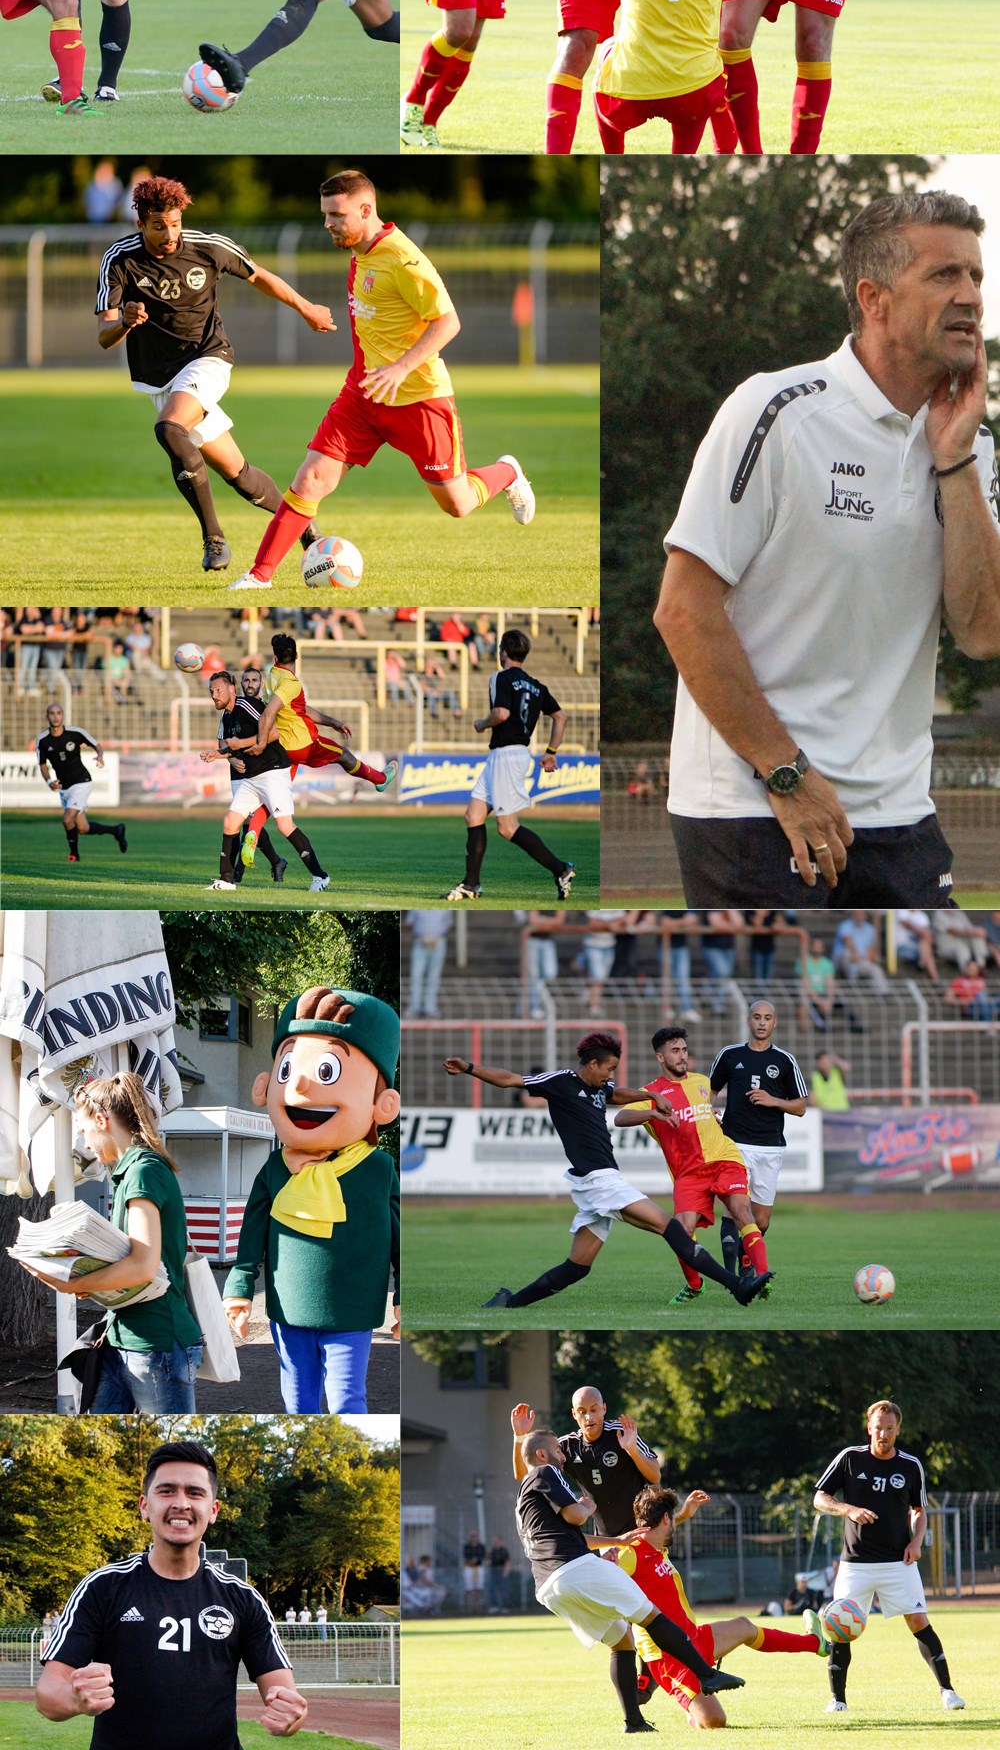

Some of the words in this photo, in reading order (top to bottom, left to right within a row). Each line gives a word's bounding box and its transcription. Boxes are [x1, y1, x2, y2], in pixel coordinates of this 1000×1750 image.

[160, 278, 181, 300] 23
[830, 461, 865, 477] JAKO
[824, 480, 875, 514] JUNG
[835, 488, 863, 499] SPORT
[751, 1075, 761, 1089] 5
[591, 1469, 602, 1485] 5
[872, 1476, 887, 1492] 31
[158, 1616, 191, 1652] 21
